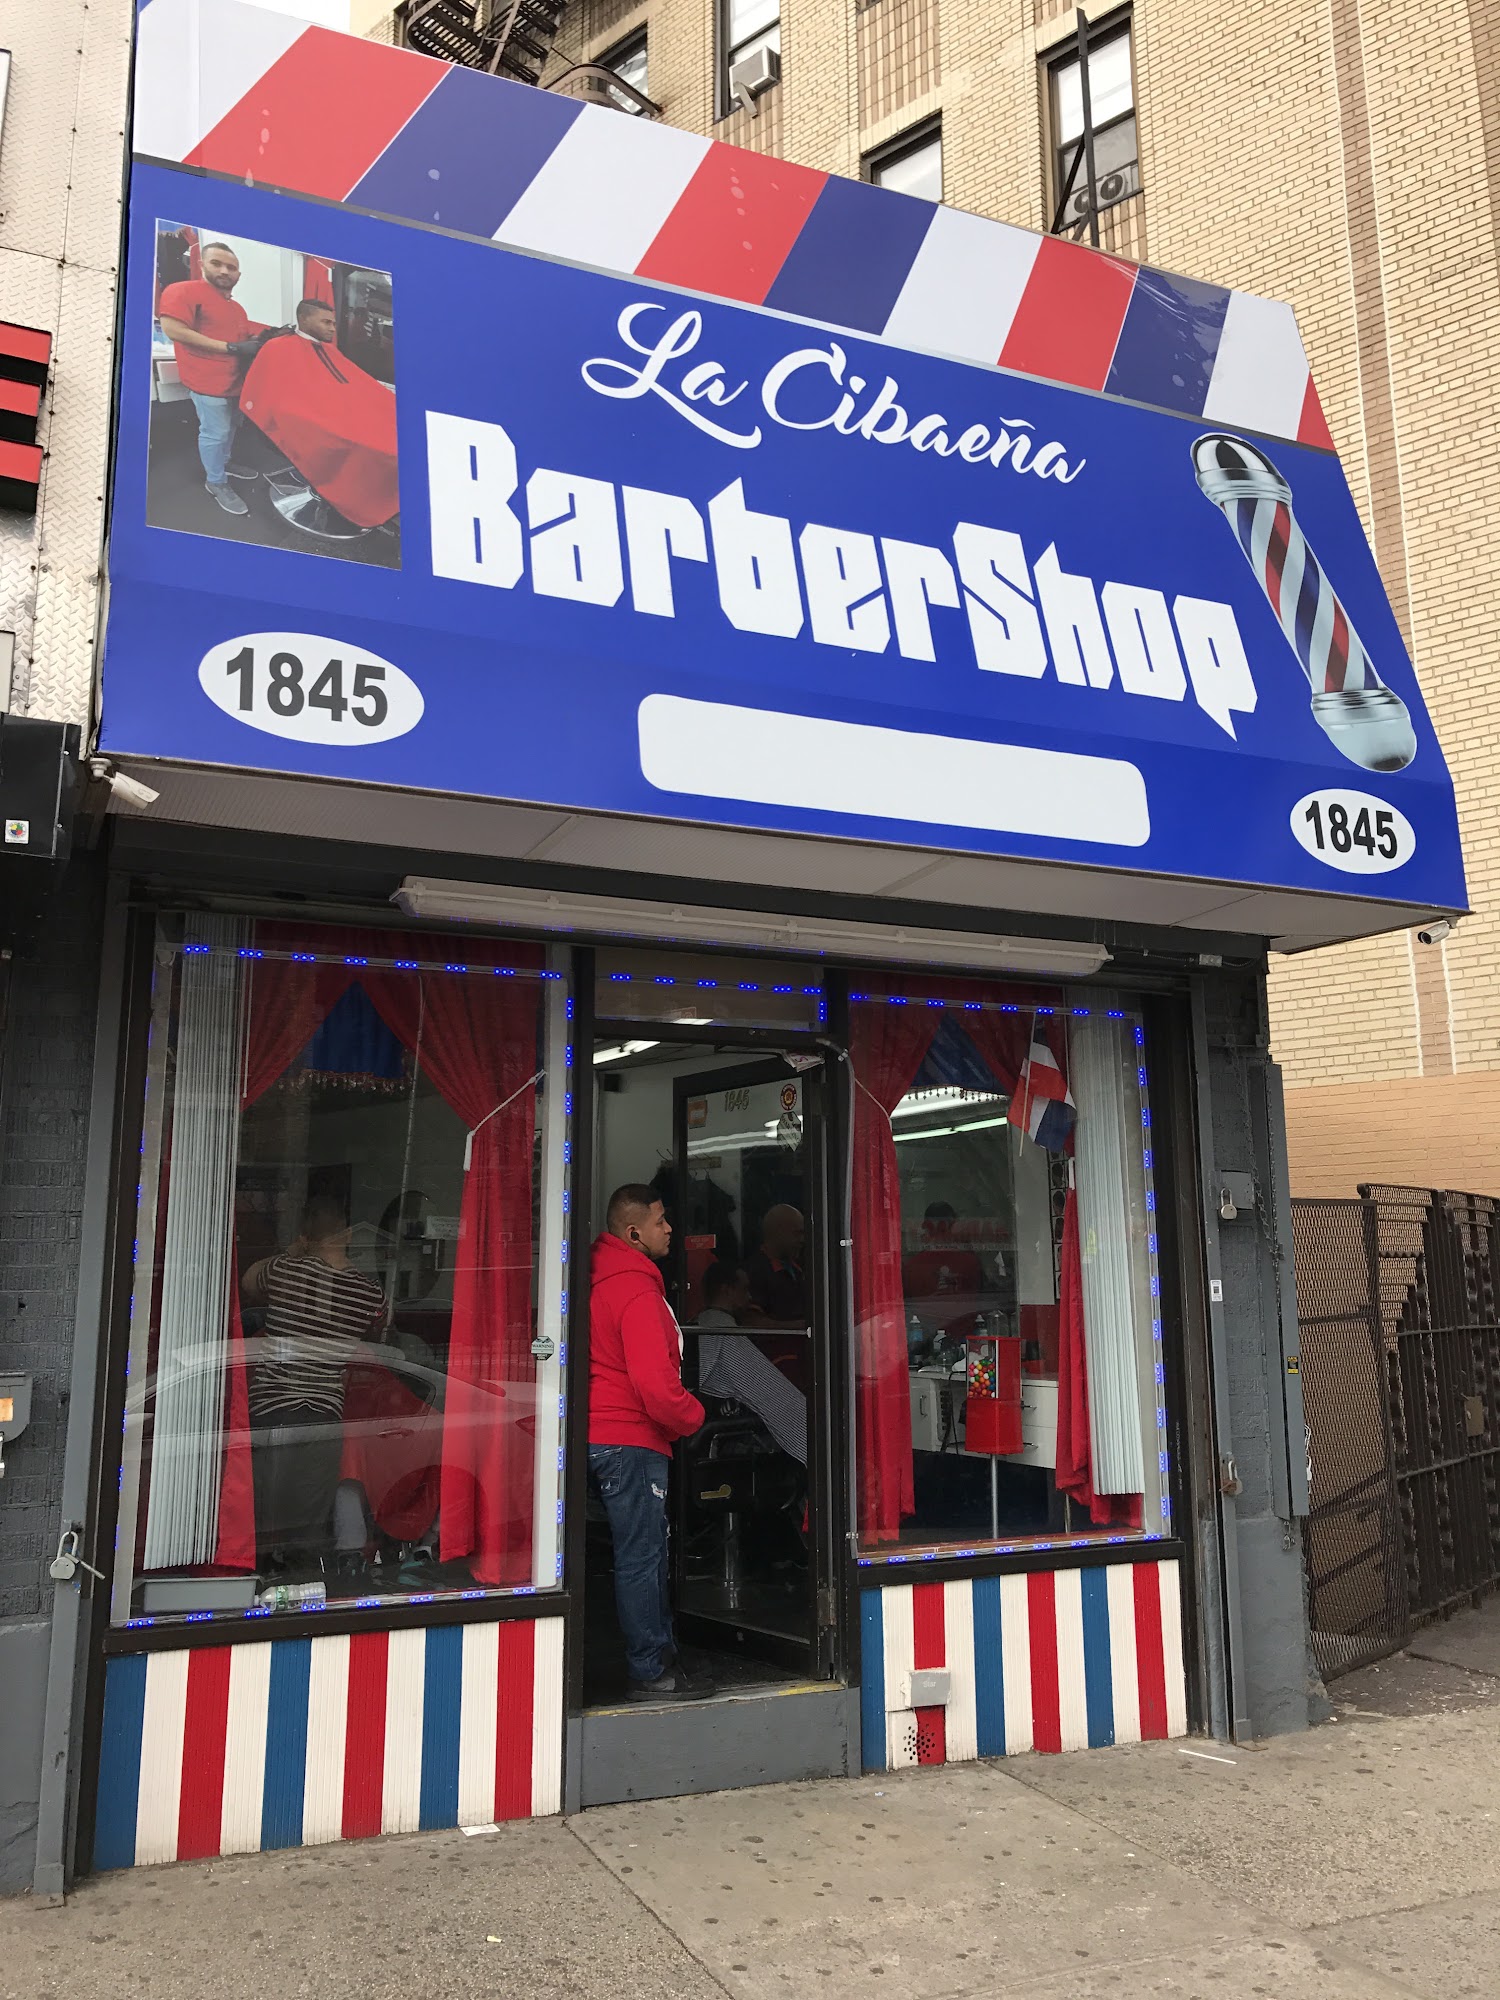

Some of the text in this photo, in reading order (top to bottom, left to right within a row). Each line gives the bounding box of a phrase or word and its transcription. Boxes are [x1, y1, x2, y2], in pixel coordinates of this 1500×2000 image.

[581, 302, 1087, 484] La Cibaeña
[425, 409, 1259, 742] BarberShop
[226, 646, 389, 728] 1845
[1305, 800, 1398, 860] 1845
[724, 1089, 750, 1112] 1845
